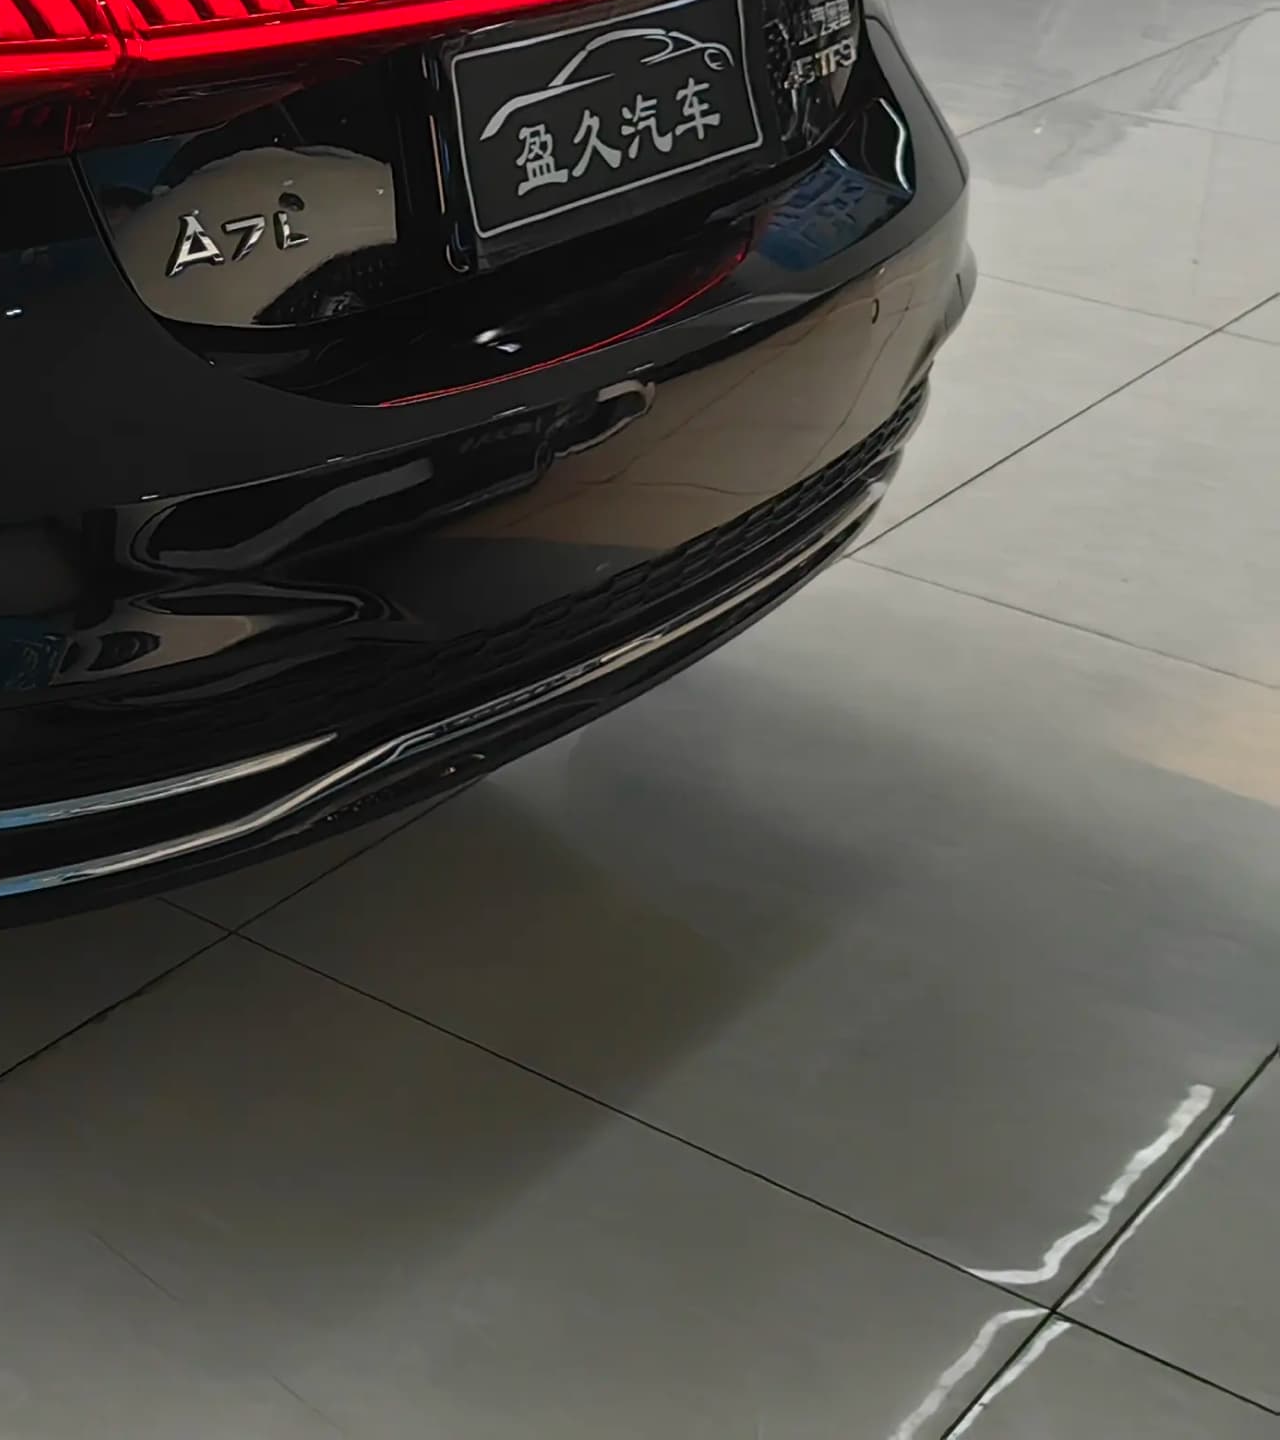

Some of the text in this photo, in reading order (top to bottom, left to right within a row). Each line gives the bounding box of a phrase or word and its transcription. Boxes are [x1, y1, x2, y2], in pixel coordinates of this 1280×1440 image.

[516, 77, 721, 196] 盈久汽车
[165, 209, 310, 277] A7L
